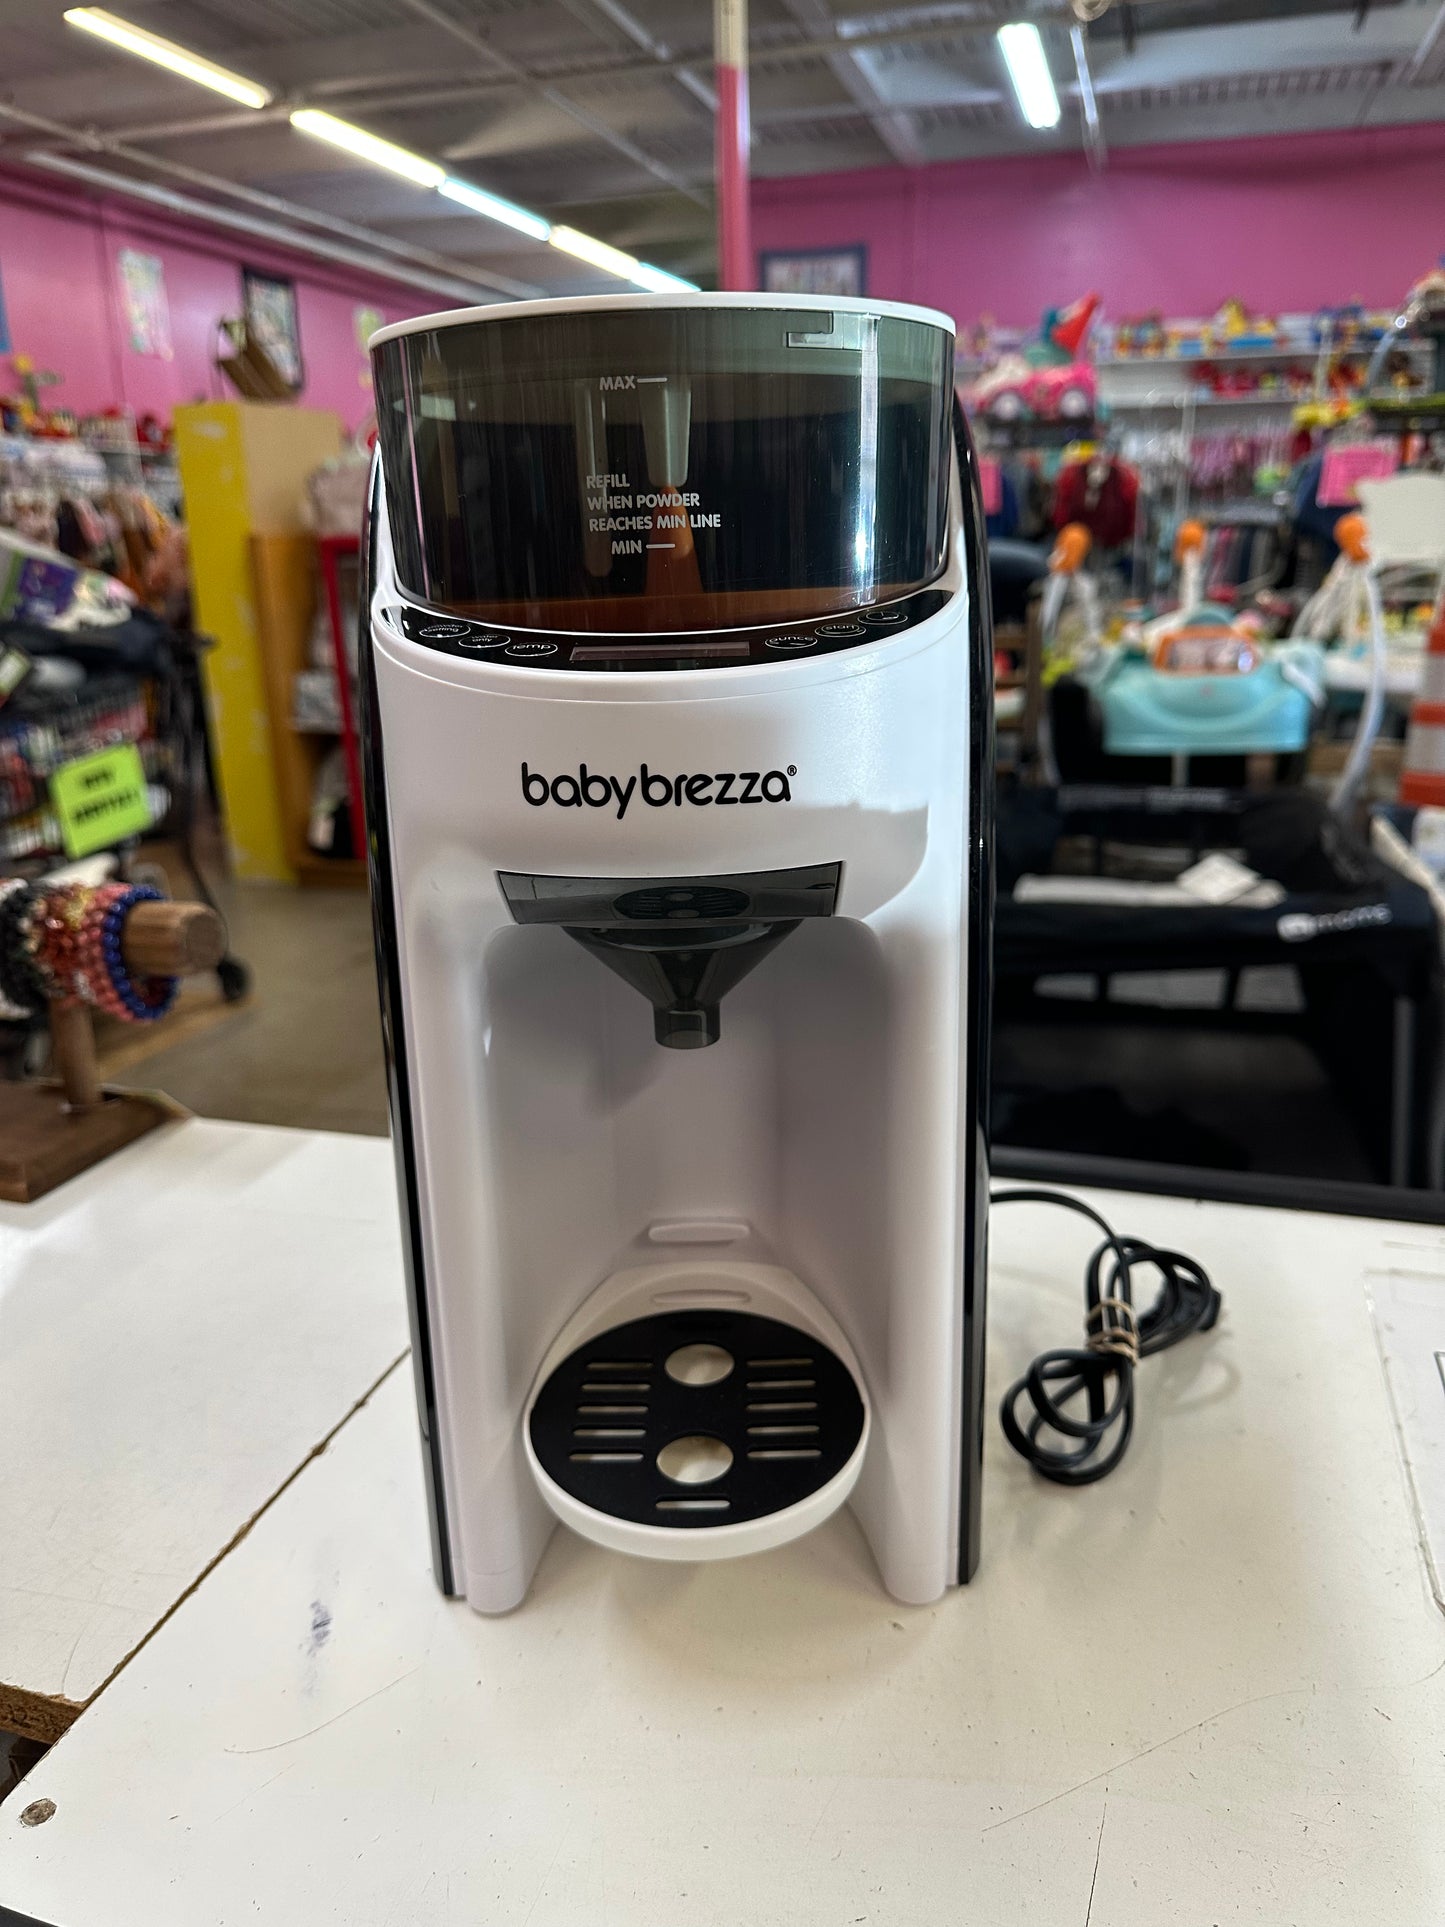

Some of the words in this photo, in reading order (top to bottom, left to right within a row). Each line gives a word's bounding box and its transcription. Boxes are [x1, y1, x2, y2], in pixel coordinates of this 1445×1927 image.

[600, 376, 636, 391] MAX
[586, 474, 630, 489] REFILL
[587, 495, 633, 511] WHEN
[636, 493, 700, 509] POWDER
[589, 516, 653, 532] REACHES
[657, 515, 686, 529] MIN
[690, 514, 721, 528] LINE
[611, 540, 642, 555] MIN
